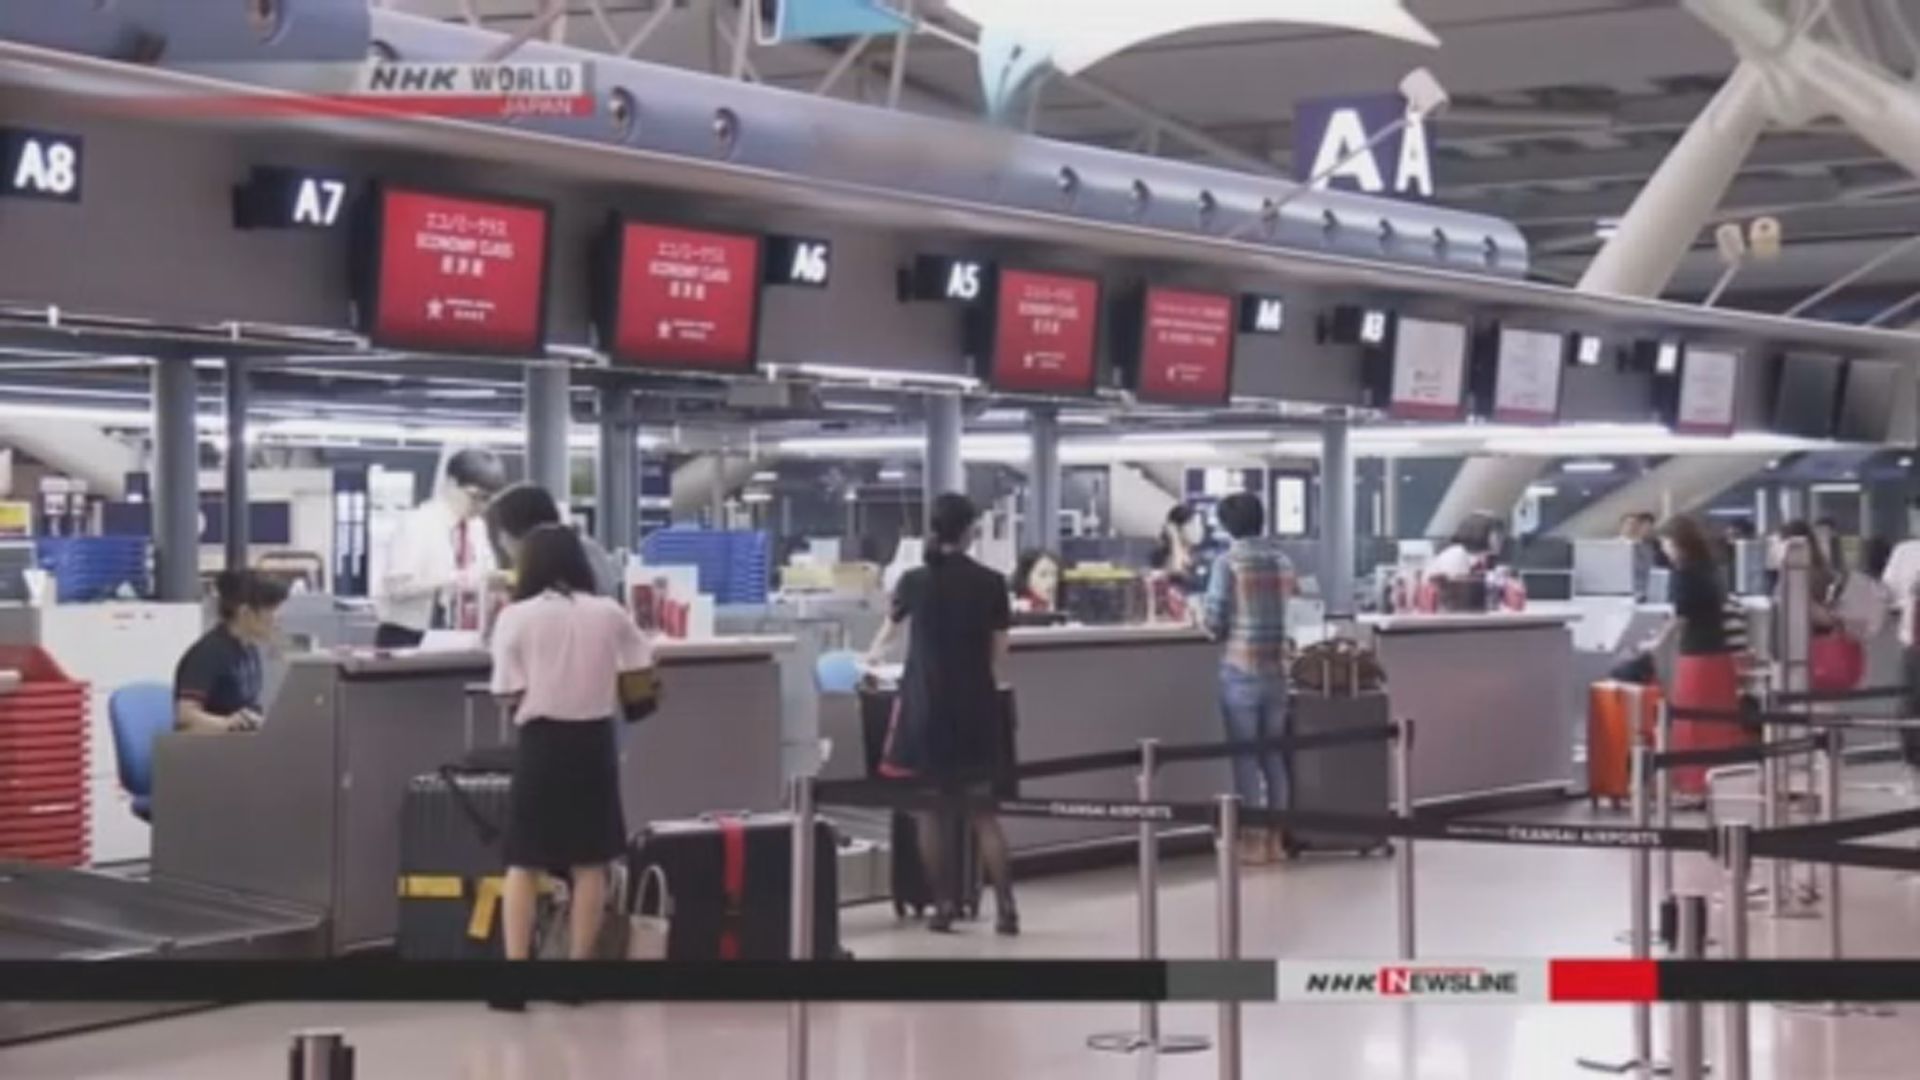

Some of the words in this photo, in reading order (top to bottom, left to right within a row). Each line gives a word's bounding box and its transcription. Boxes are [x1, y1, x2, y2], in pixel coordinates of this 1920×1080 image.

[13, 139, 76, 194] A8
[1310, 108, 1384, 193] A
[1394, 108, 1433, 197] A
[292, 178, 346, 226] A7
[415, 231, 477, 254] ECONOMY
[790, 242, 828, 282] A6
[947, 261, 981, 299] A5
[1109, 804, 1172, 819] AIRPORTS
[1582, 831, 1661, 845] AIRPORTS
